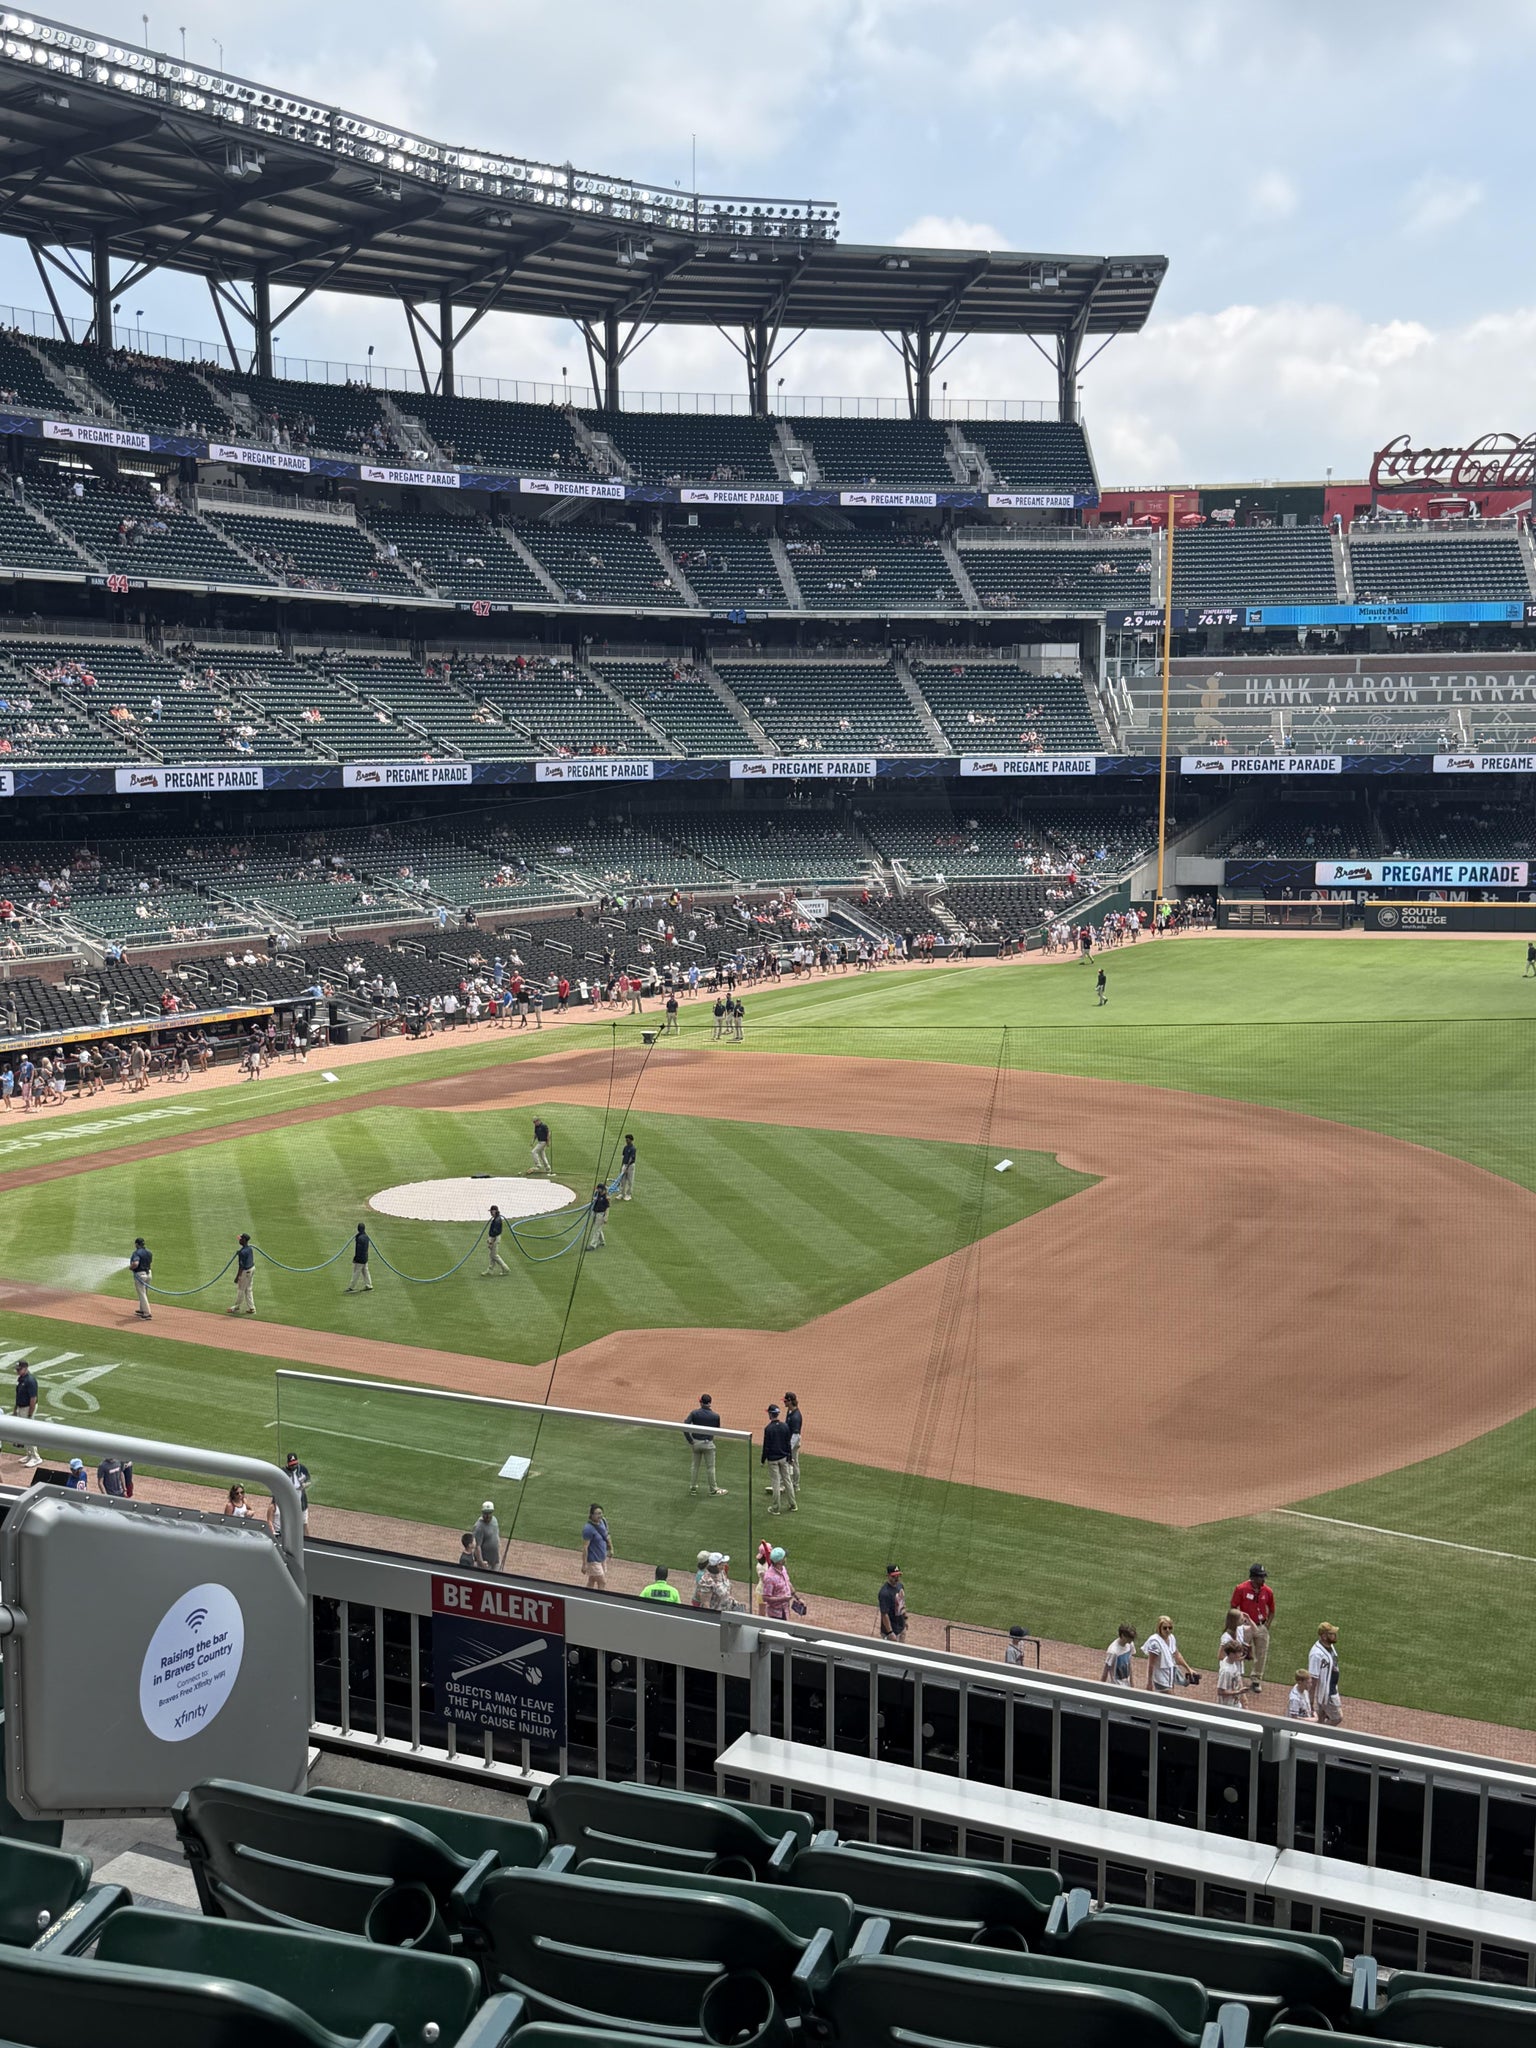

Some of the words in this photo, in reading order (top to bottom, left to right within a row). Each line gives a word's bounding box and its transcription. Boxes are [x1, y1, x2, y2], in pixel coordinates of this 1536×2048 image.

[78, 429, 113, 443] PREGAME
[116, 434, 146, 448] PARADE
[242, 451, 277, 466] PREGAME
[278, 457, 307, 469] PARADE
[388, 471, 424, 483] PREGAME
[427, 475, 456, 485] PARADE
[554, 483, 589, 495] PREGAME
[592, 486, 621, 497] PARADE
[713, 492, 748, 502] PREGAME
[750, 493, 779, 503] PARADE
[871, 495, 904, 504] PREGAME
[905, 495, 933, 505] PARADE
[1015, 497, 1045, 505] PREGAME
[1046, 497, 1071, 506] PARADE
[107, 574, 129, 593] 44
[472, 600, 491, 617] 47
[1387, 607, 1408, 615] Maid
[1123, 617, 1143, 626] 2.9
[1246, 678, 1312, 704] HANK
[1327, 676, 1417, 703] AARON
[567, 765, 609, 778] PREGAME
[611, 764, 649, 777] PARADE
[772, 762, 823, 774] PREGAME
[827, 762, 871, 774] PARADE
[1003, 761, 1049, 773] PREGAME
[1052, 760, 1091, 772] PARADE
[1231, 759, 1286, 771] PREGAME
[1289, 759, 1336, 770] PARADE
[1482, 757, 1533, 770] PREGAME
[165, 772, 214, 788] PREGAME
[218, 771, 259, 787] PARADE
[386, 769, 429, 783] PREGAME
[432, 768, 468, 781] PARADE
[1382, 865, 1452, 882] PREGAME
[1458, 866, 1520, 882] PARADE
[1401, 907, 1437, 916] SOUTH
[1401, 916, 1447, 924] COLLEGE
[443, 1582, 473, 1610] BE
[480, 1590, 553, 1625] ALERT
[161, 1647, 194, 1668] Raising
[196, 1639, 211, 1653] the
[213, 1631, 228, 1645] bar
[153, 1675, 162, 1686] in
[165, 1661, 195, 1682] Braves
[197, 1643, 233, 1666] Country
[177, 1674, 201, 1689] Connect
[201, 1670, 209, 1678] to:
[159, 1693, 179, 1707] Braves
[180, 1687, 193, 1697] Free
[194, 1677, 213, 1691] Xfinity
[445, 1681, 492, 1699] OBJECTS
[495, 1691, 518, 1705] MAY
[521, 1696, 554, 1713] LEAVE
[174, 1704, 208, 1728] xfinity
[448, 1694, 469, 1708] THE
[472, 1699, 518, 1718] PLAYING
[521, 1709, 551, 1725] FIELD
[443, 1707, 452, 1717] &
[455, 1709, 477, 1722] MAY
[480, 1714, 515, 1731] CAUSE
[519, 1722, 558, 1739] INJURY
